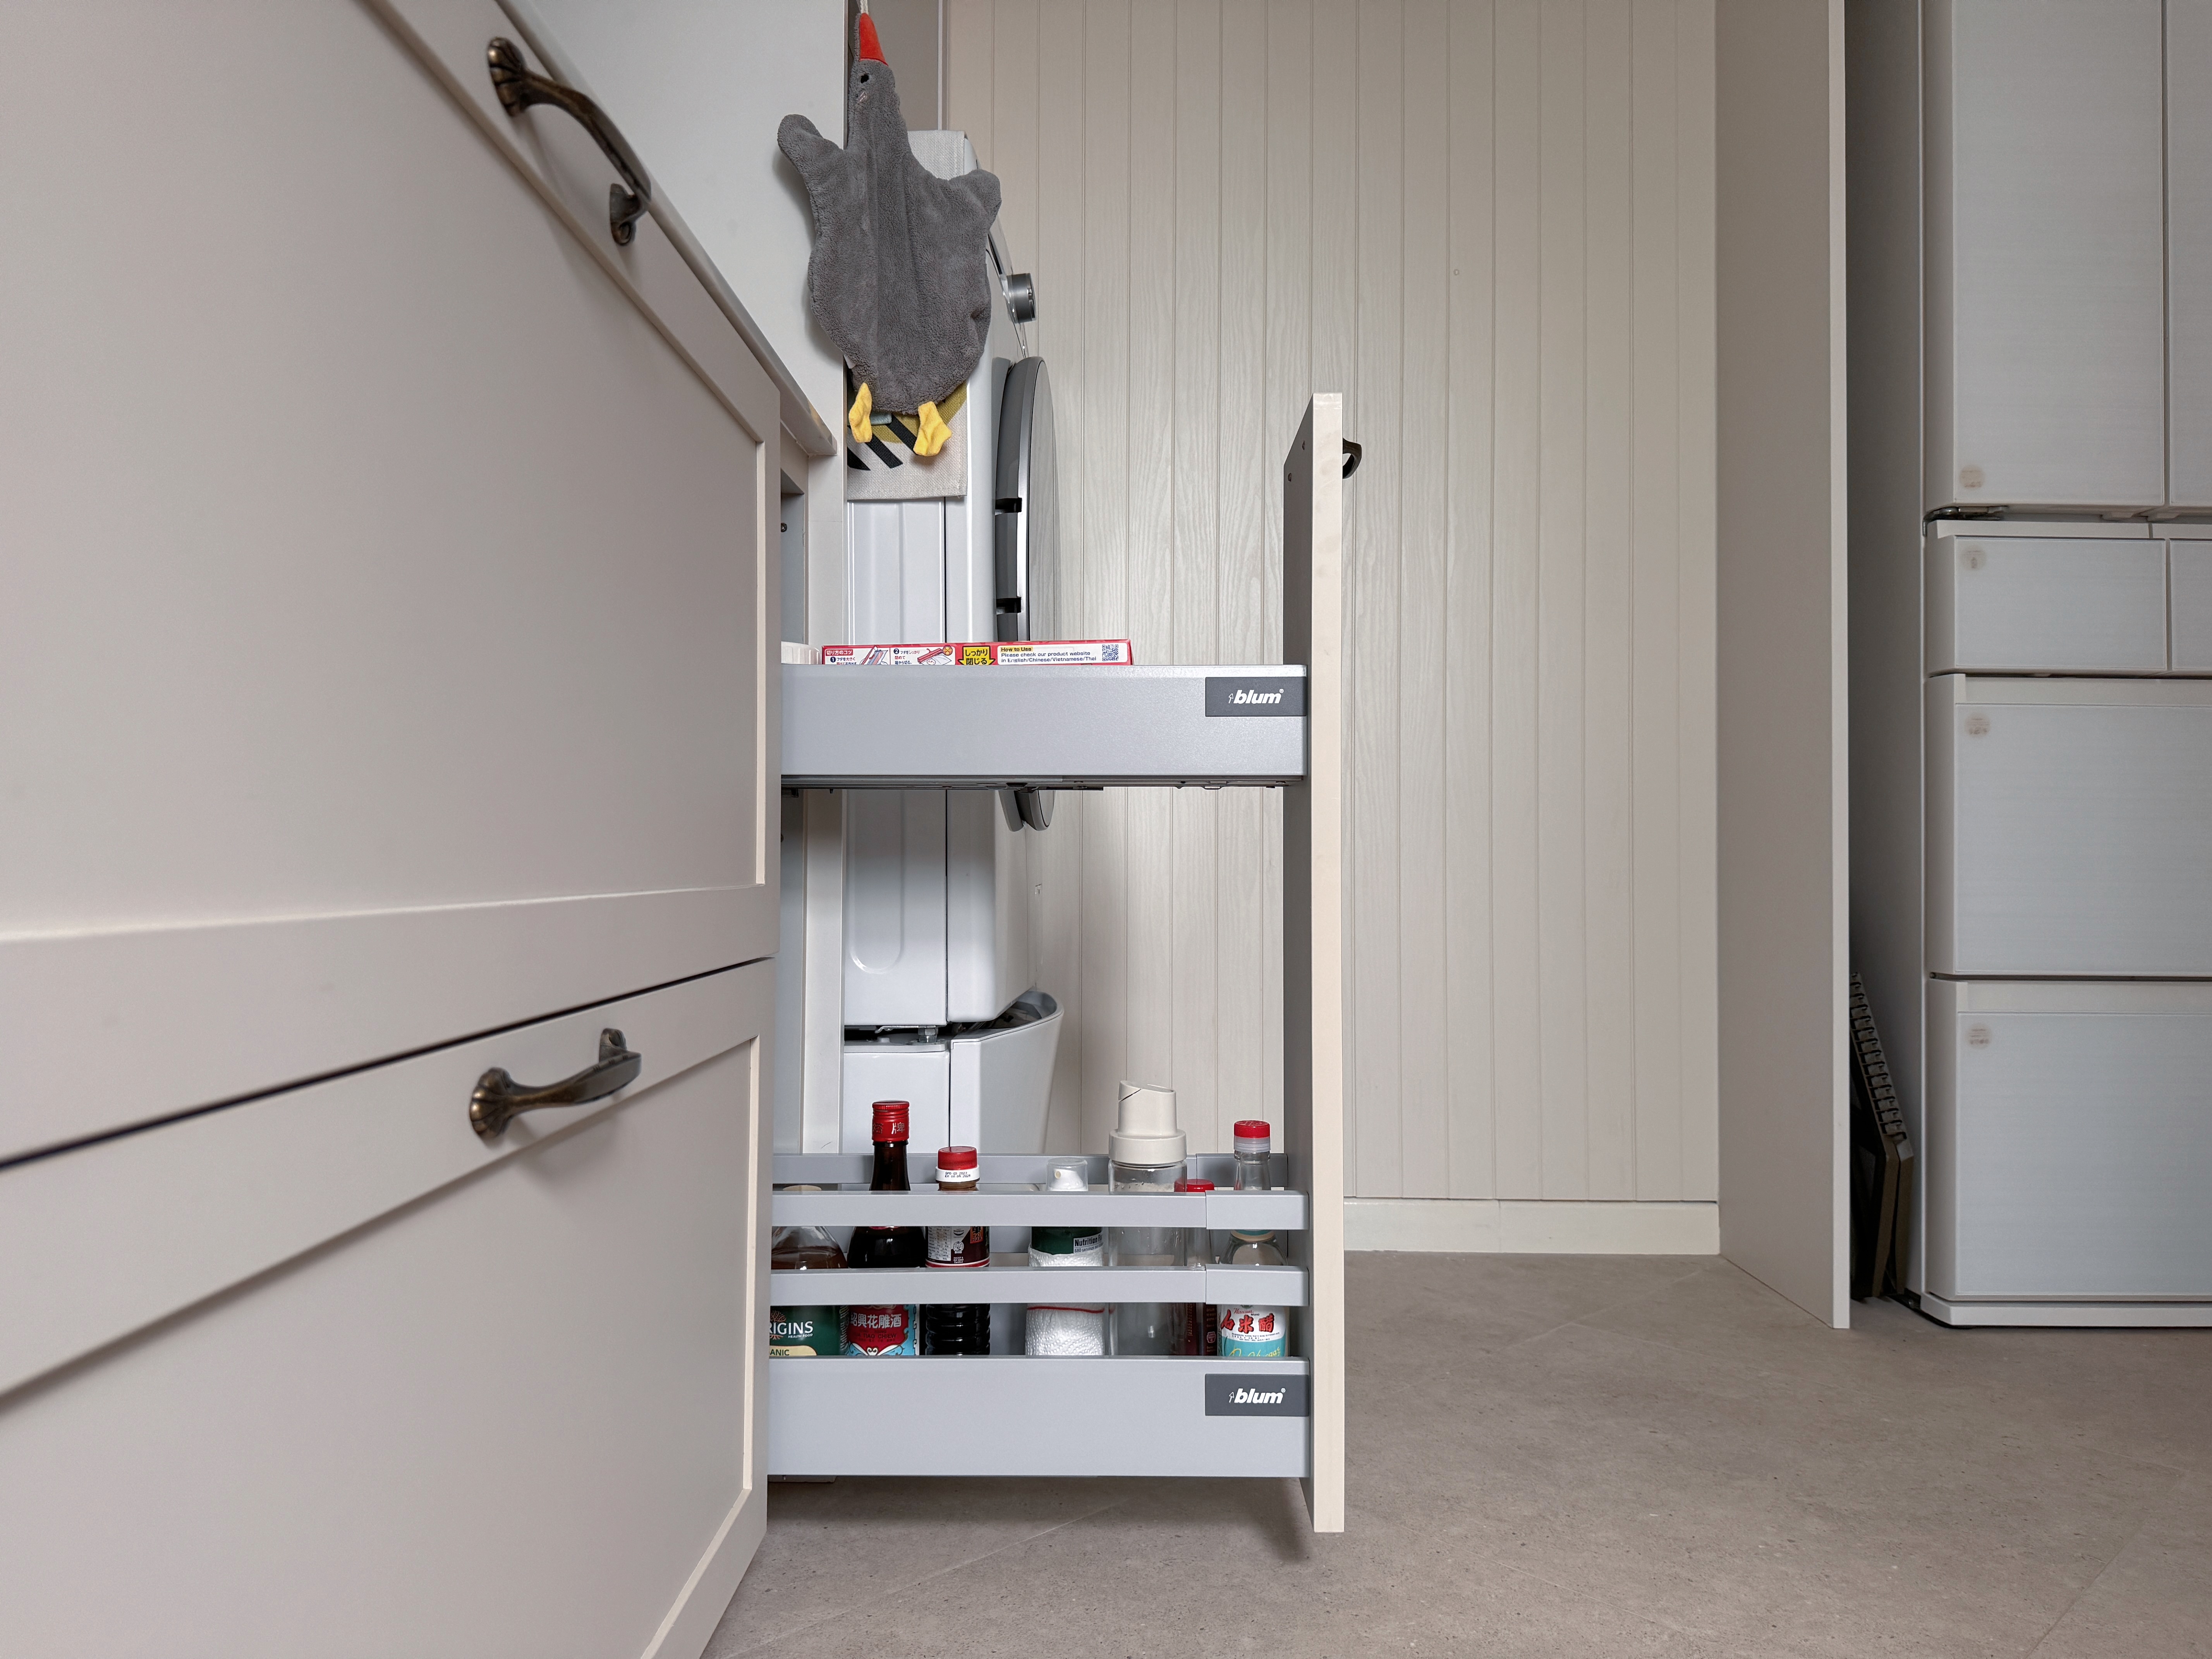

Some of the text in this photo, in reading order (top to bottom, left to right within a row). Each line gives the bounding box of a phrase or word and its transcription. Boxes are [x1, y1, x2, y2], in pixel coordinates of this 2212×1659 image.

[1233, 689, 1282, 704] blum
[1075, 1237, 1098, 1247] Nutrition
[769, 1321, 814, 1335] RIGINS
[850, 1312, 902, 1329] 紹興花雕酒
[1220, 1309, 1275, 1334] 白米醋
[1234, 1388, 1283, 1404] blum
